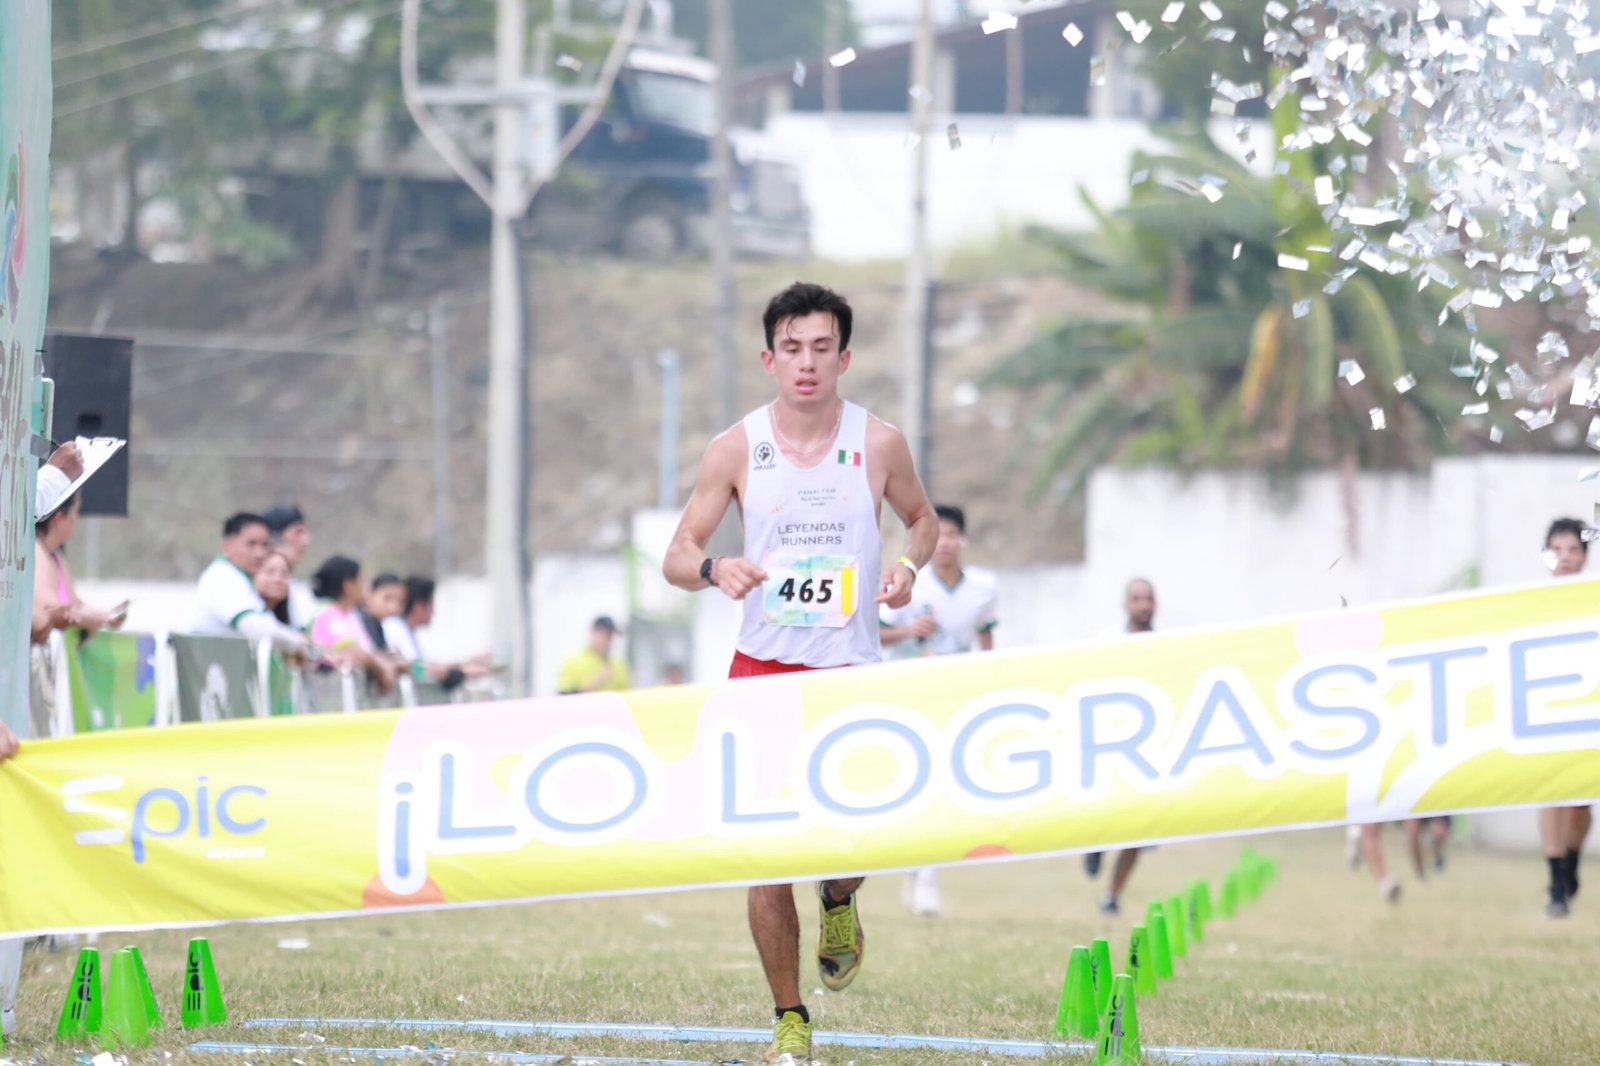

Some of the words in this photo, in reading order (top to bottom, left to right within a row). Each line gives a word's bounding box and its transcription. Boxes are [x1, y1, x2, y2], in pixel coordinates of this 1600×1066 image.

[777, 522, 845, 535] LEYENDAS
[781, 535, 843, 546] RUNNERS
[778, 578, 834, 604] 465
[722, 630, 1600, 824] LOGRASTE
